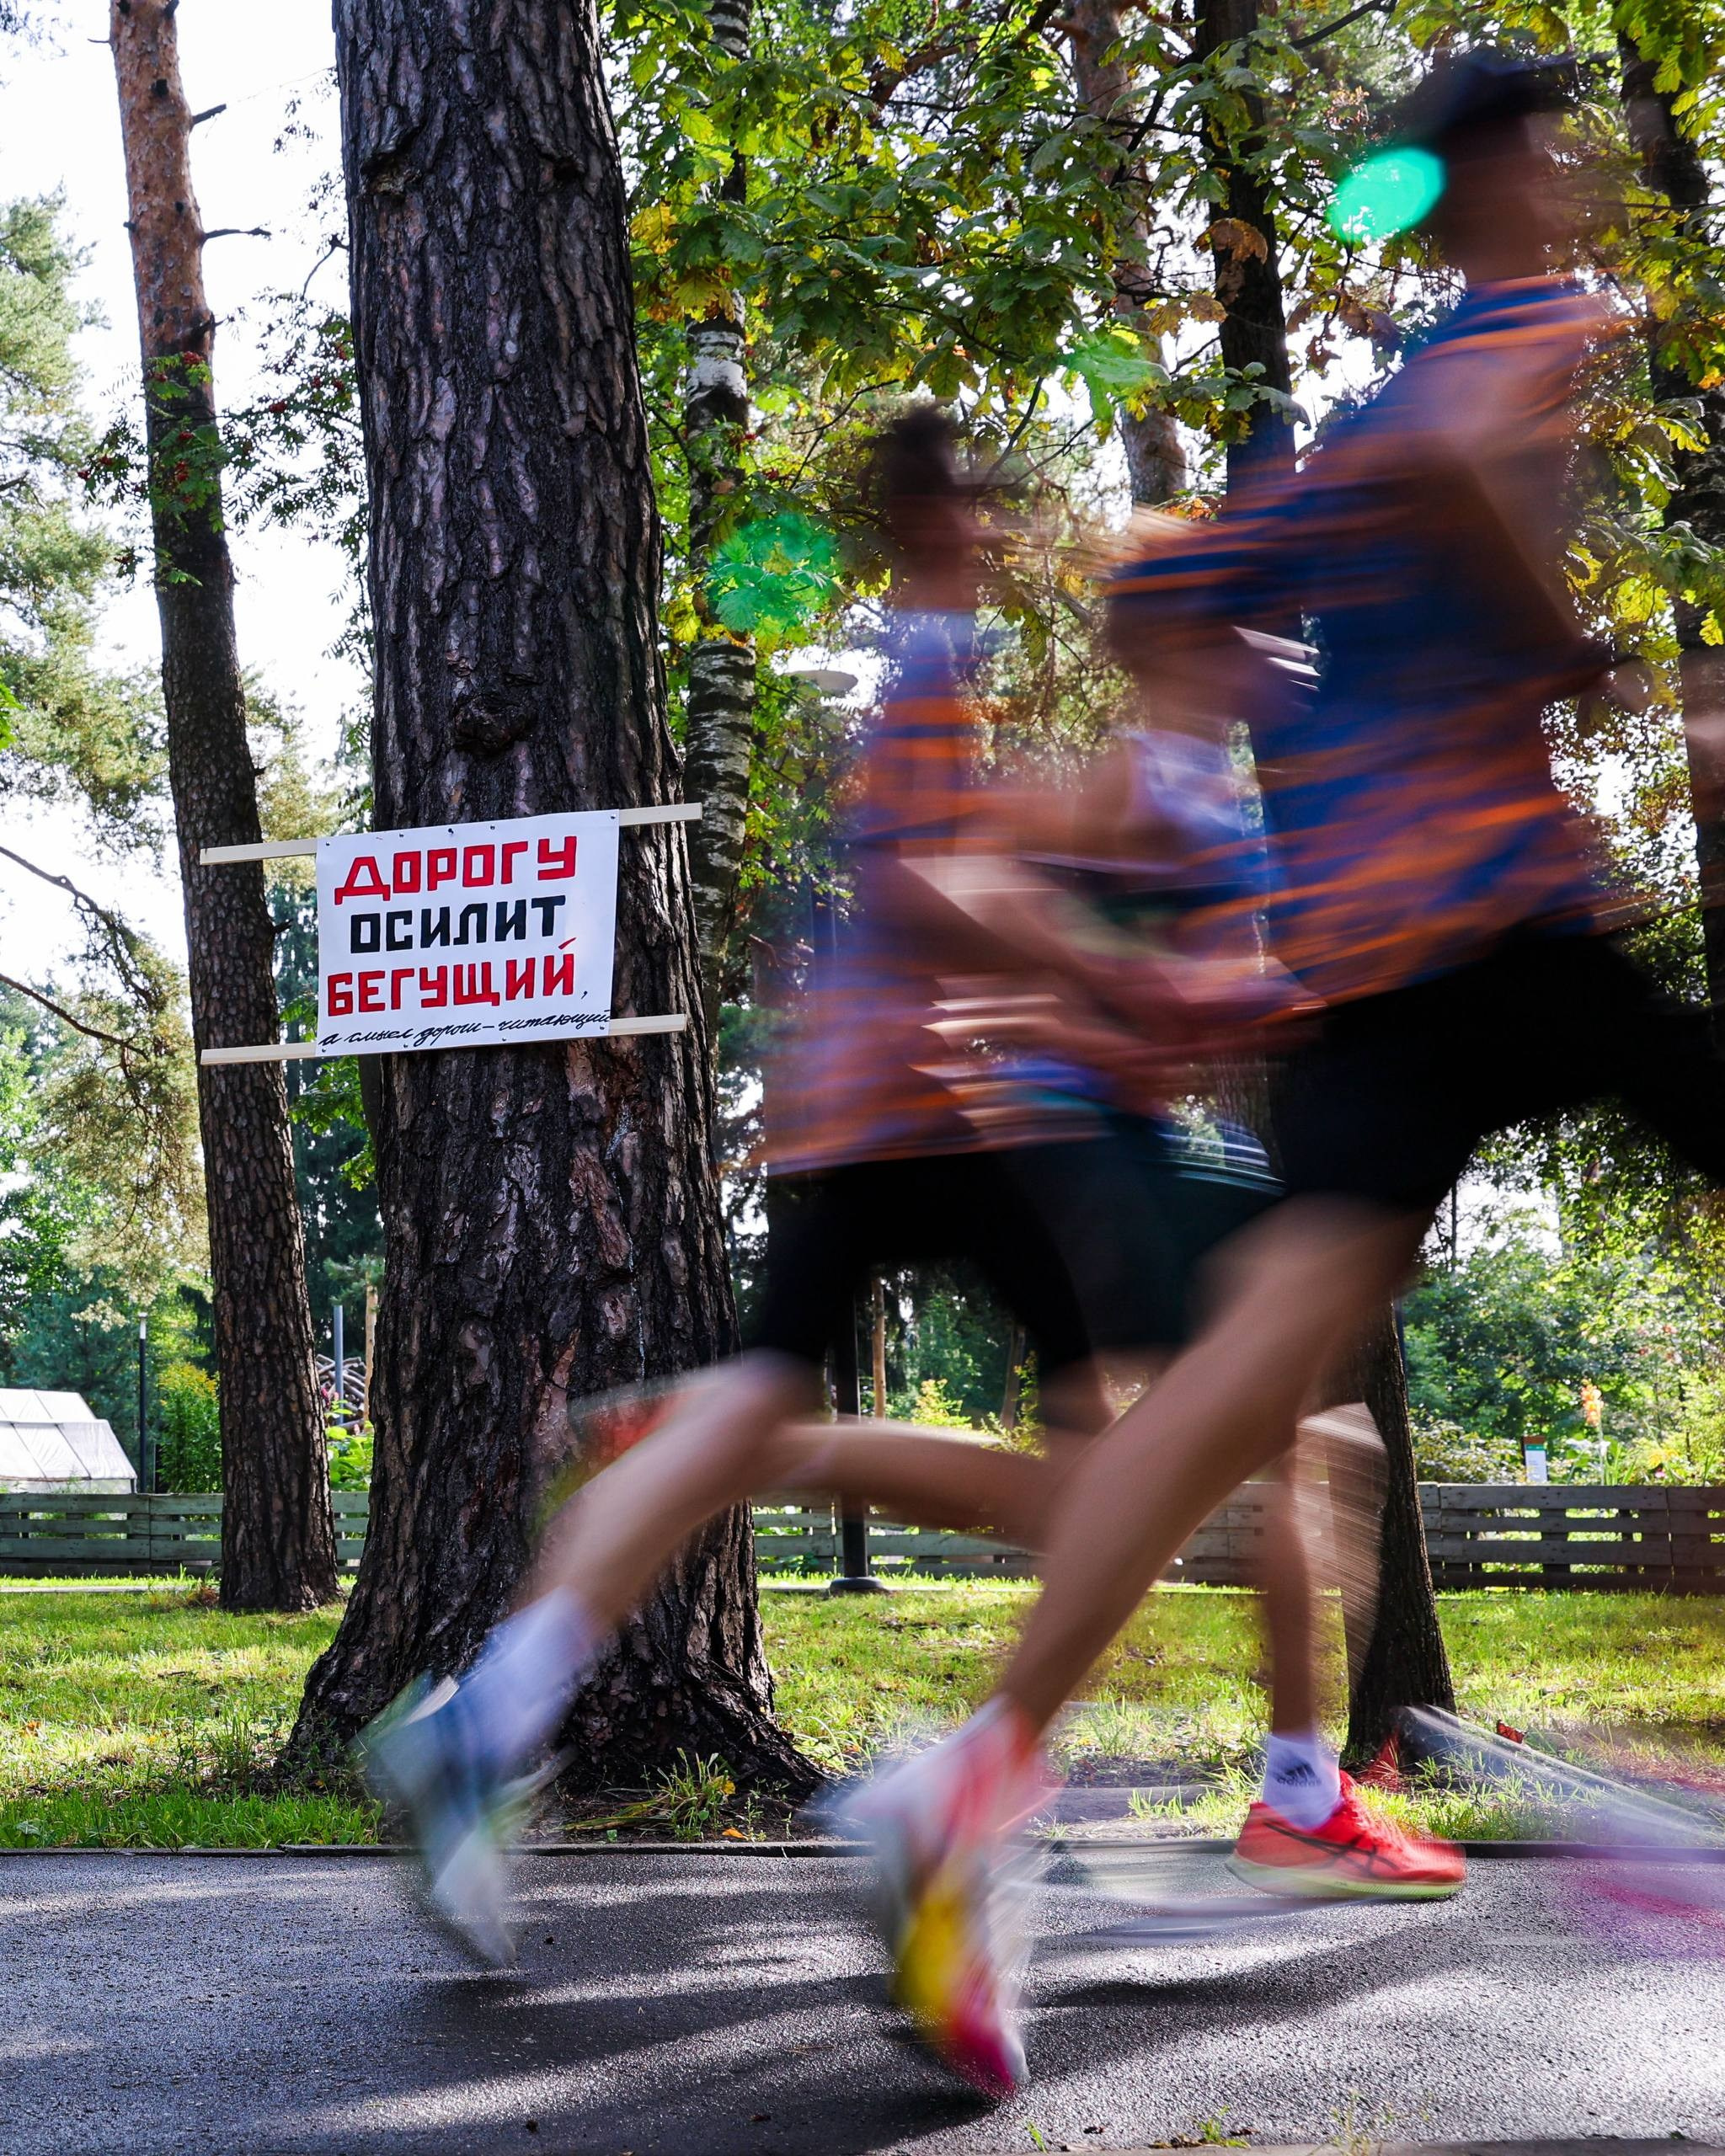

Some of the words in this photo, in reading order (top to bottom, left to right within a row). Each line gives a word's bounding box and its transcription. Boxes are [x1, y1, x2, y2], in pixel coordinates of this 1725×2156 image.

[334, 835, 578, 905] ДОРОГУ
[350, 894, 566, 954] ОСИЛИТ
[318, 1033, 343, 1046] а
[344, 1027, 414, 1043] смысл
